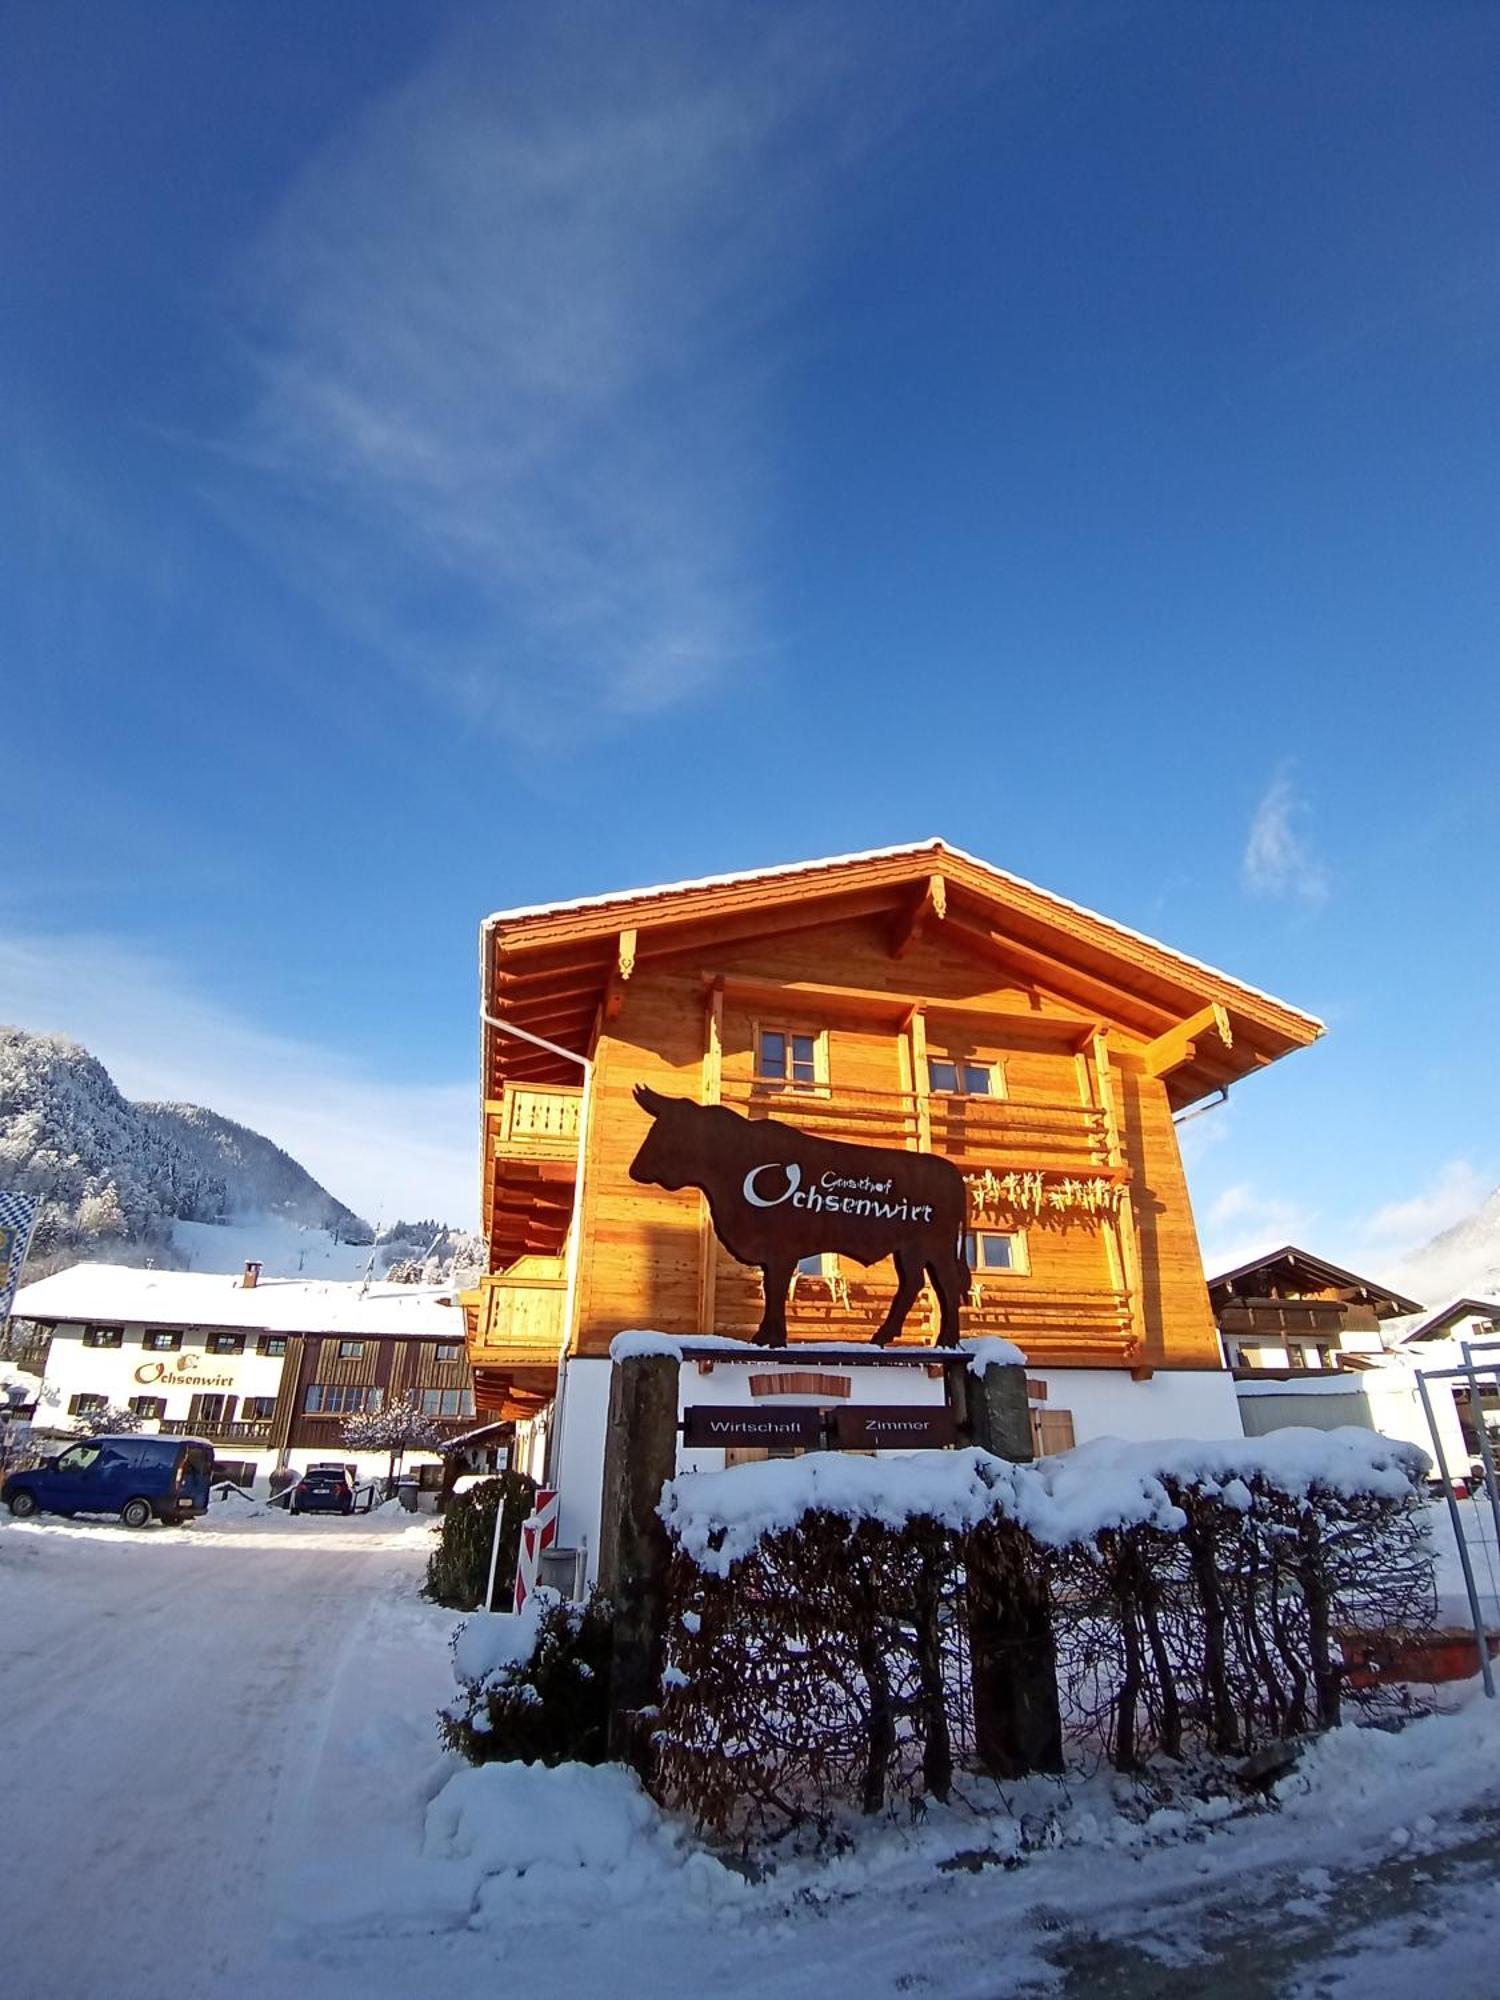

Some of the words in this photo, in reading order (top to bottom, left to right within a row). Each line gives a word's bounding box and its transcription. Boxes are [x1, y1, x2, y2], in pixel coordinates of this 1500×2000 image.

[743, 1163, 933, 1222] Ochsenwirt
[134, 1362, 234, 1387] Ochsenwirt
[710, 1420, 801, 1433] Wirtschaft
[865, 1419, 930, 1431] Zimmer
